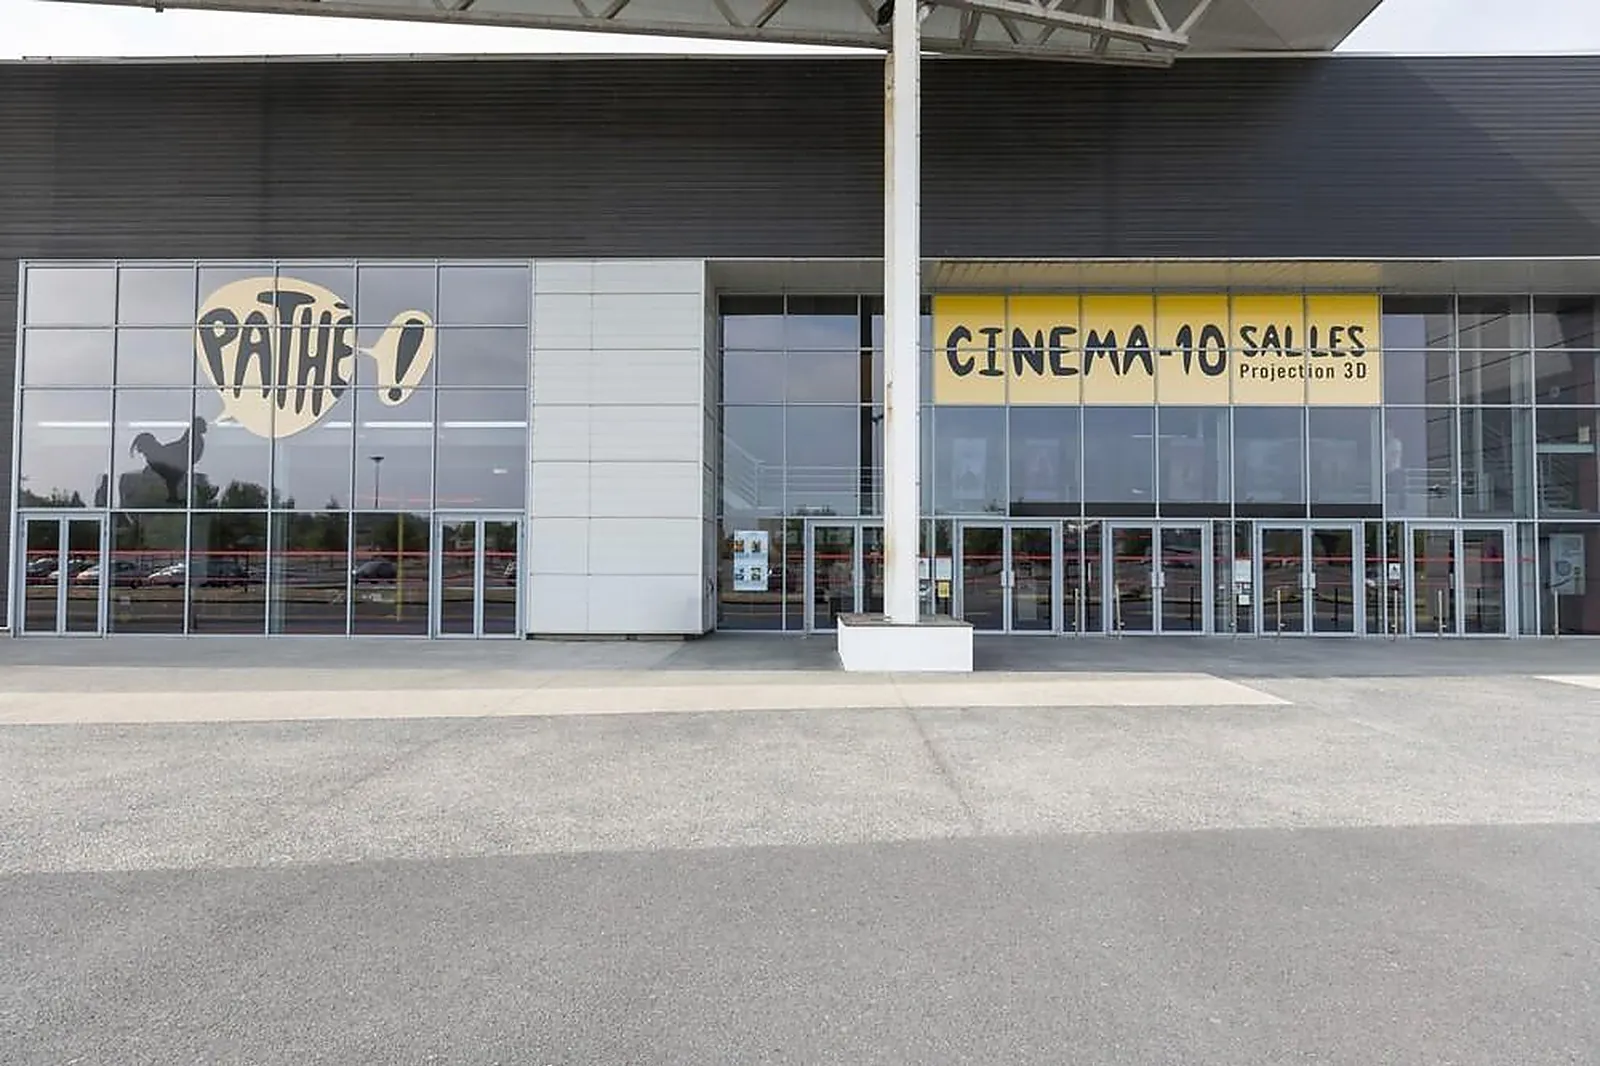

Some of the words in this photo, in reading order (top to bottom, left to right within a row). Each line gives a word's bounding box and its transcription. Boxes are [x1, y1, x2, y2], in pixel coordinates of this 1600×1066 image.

[1239, 325, 1366, 357] SALLES
[1240, 363, 1335, 381] Projection
[1344, 362, 1367, 379] 3D
